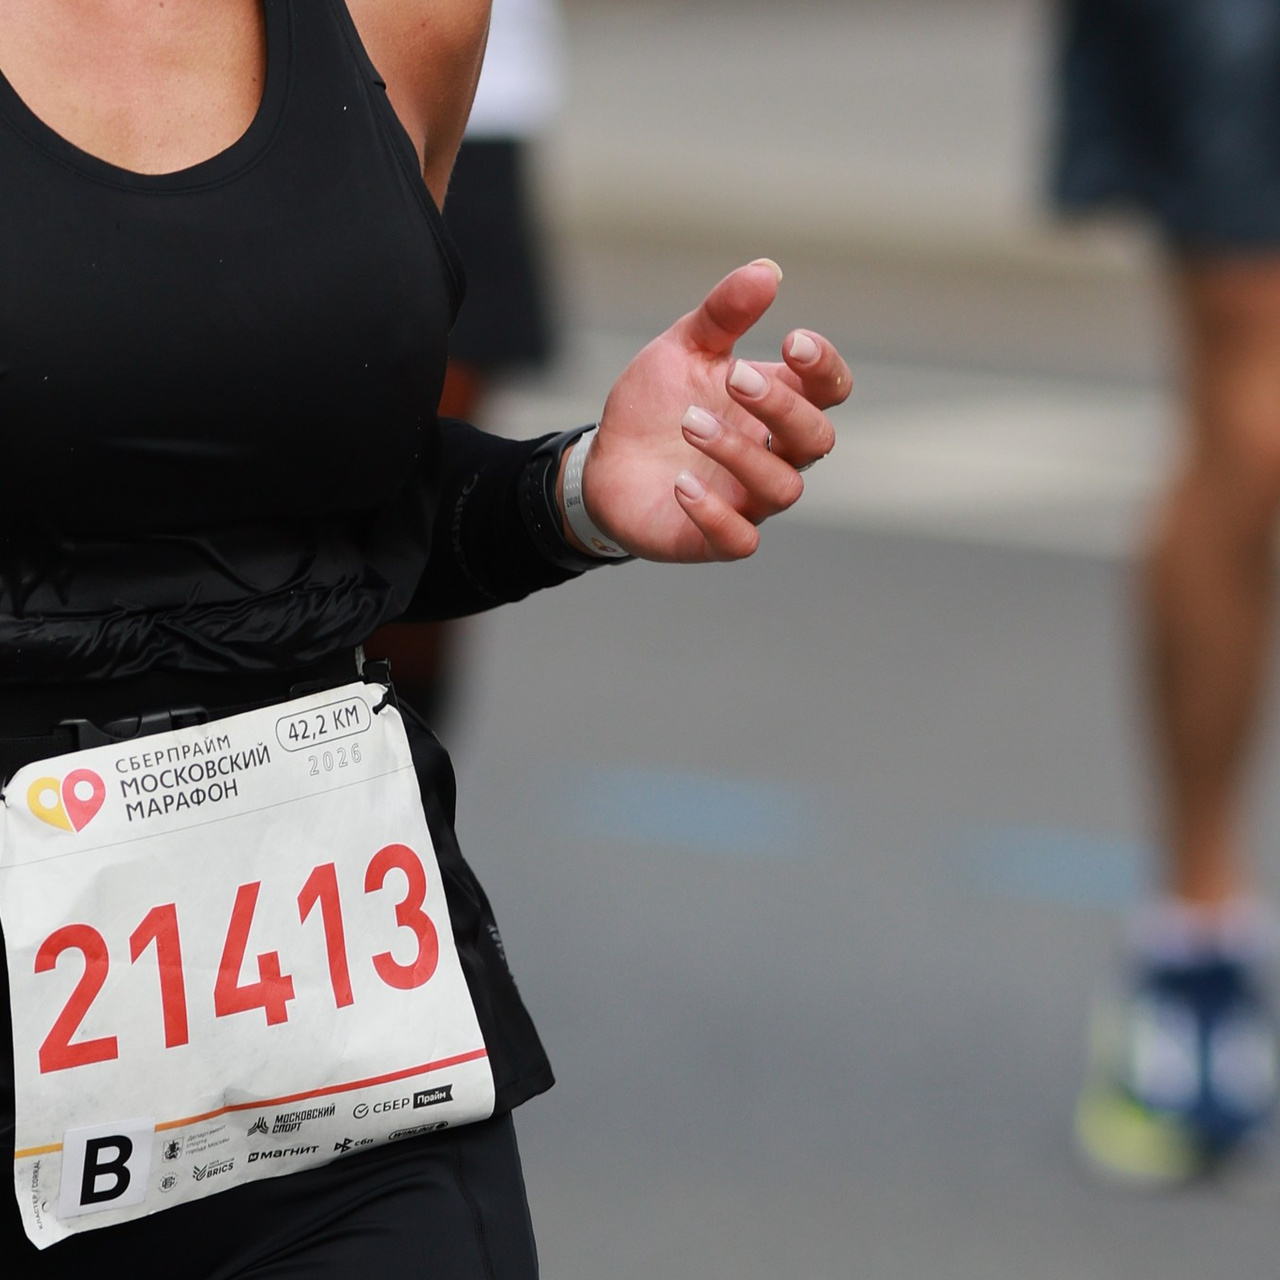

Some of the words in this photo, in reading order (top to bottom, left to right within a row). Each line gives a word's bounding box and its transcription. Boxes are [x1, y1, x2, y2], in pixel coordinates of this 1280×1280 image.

[288, 714, 328, 742] 42,2
[115, 734, 231, 773] СБЕРПРАЙМ
[119, 741, 271, 798] МОСКОВСКИЙ
[308, 743, 363, 776] 2026
[125, 778, 239, 822] МАРАФОН
[34, 843, 439, 1075] 21413
[274, 1103, 336, 1125] МОСКОВСКИЙ
[373, 1098, 410, 1114] СБЕР
[417, 1090, 447, 1105] Прайм
[272, 1122, 303, 1134] СПОРТ
[80, 1135, 133, 1206] B
[206, 1162, 234, 1179] BRICS
